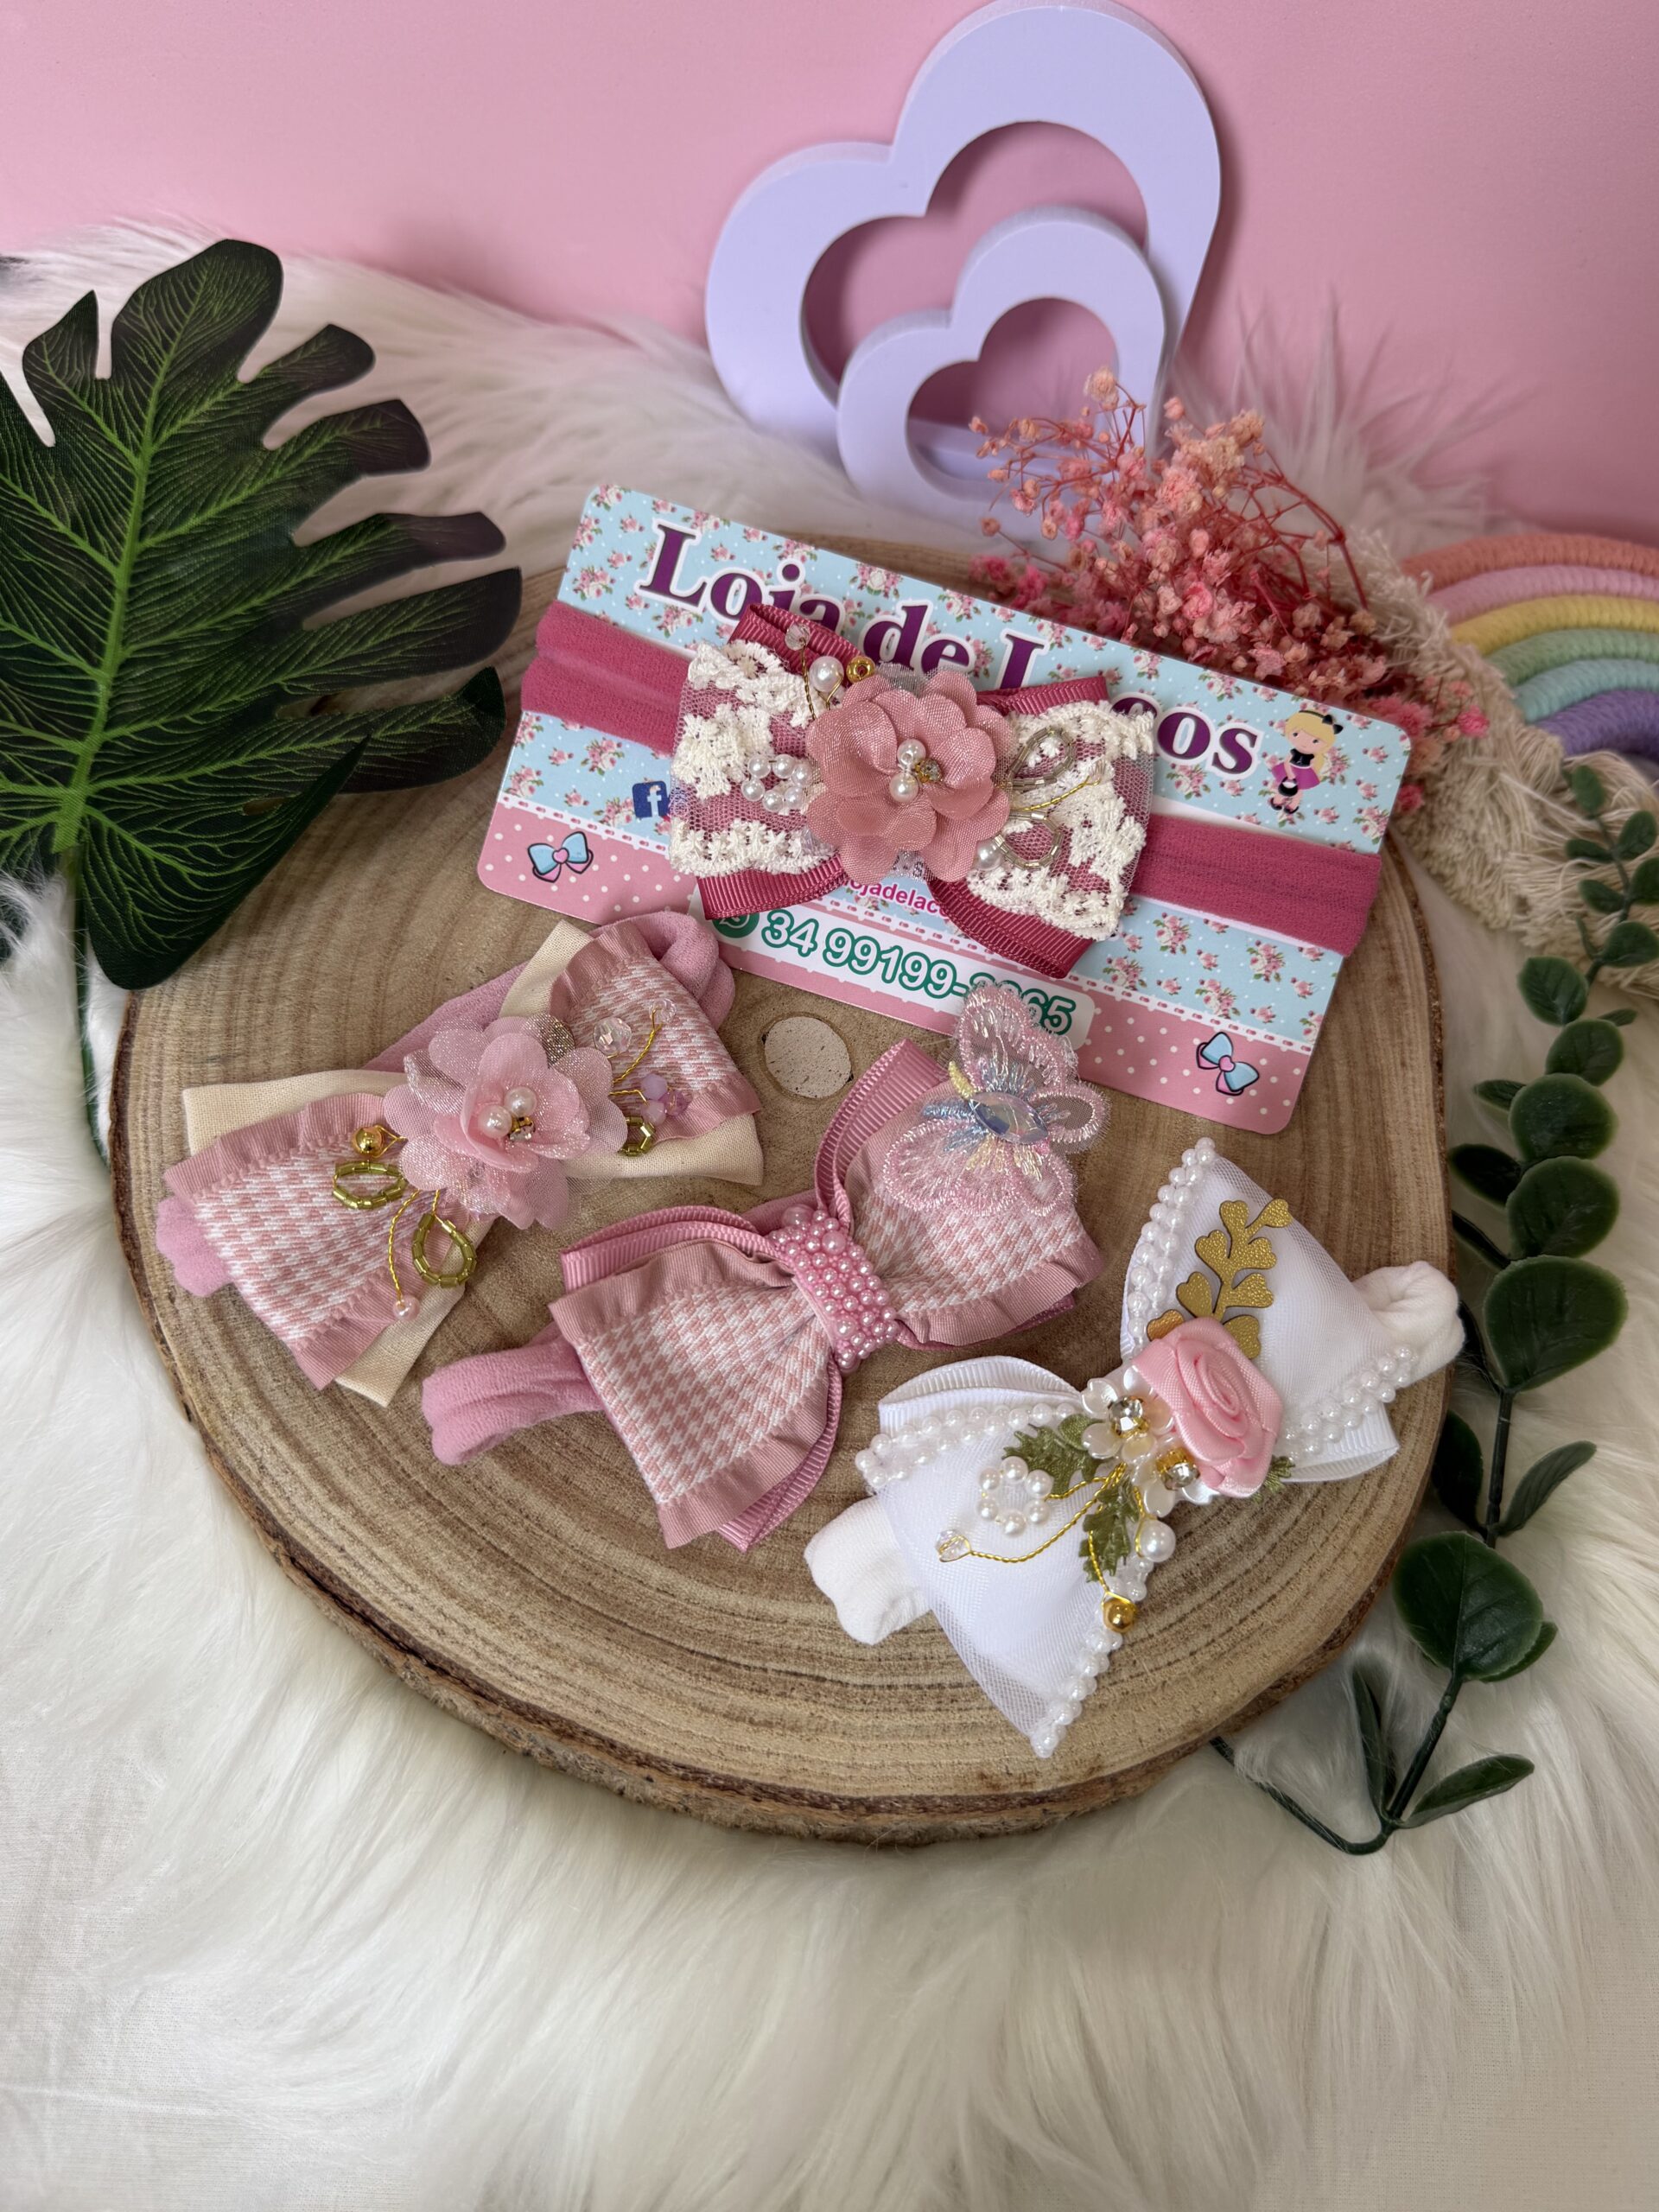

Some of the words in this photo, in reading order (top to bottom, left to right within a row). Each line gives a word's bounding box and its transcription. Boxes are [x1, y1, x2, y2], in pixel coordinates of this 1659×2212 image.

[861, 603, 970, 677] de
[761, 908, 818, 957] 34
[823, 927, 1077, 1036] 99199-65
